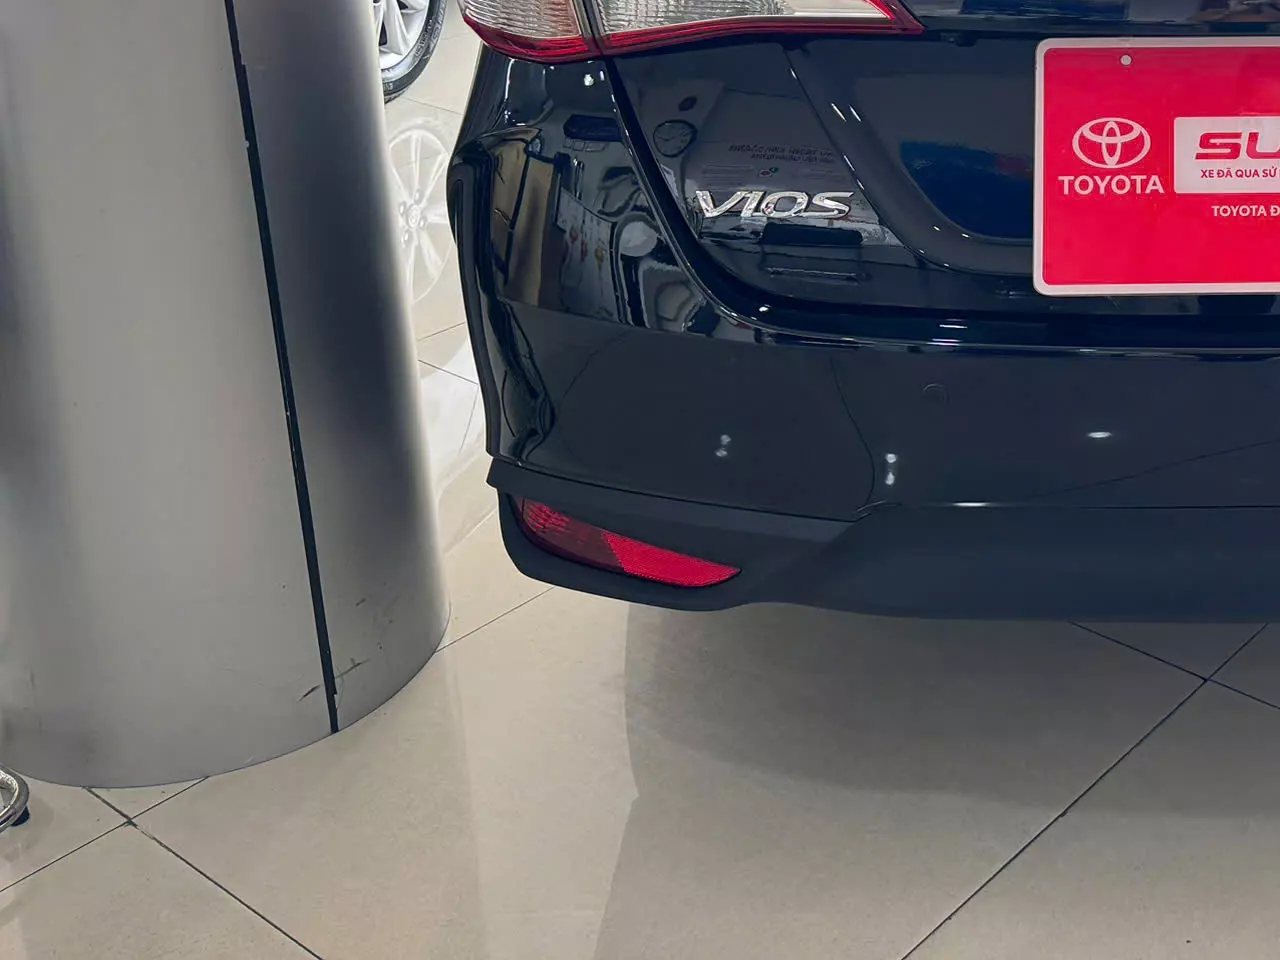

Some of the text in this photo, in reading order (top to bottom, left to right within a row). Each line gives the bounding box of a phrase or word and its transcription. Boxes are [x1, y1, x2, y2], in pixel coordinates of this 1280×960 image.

[1200, 169, 1214, 178] XE
[1217, 167, 1233, 178] ĐÃ
[1235, 168, 1260, 178] QUA
[1262, 166, 1277, 178] SỬ
[1058, 175, 1165, 195] TOYOTA
[696, 191, 853, 218] VIOS
[1211, 205, 1266, 217] TOYOTA
